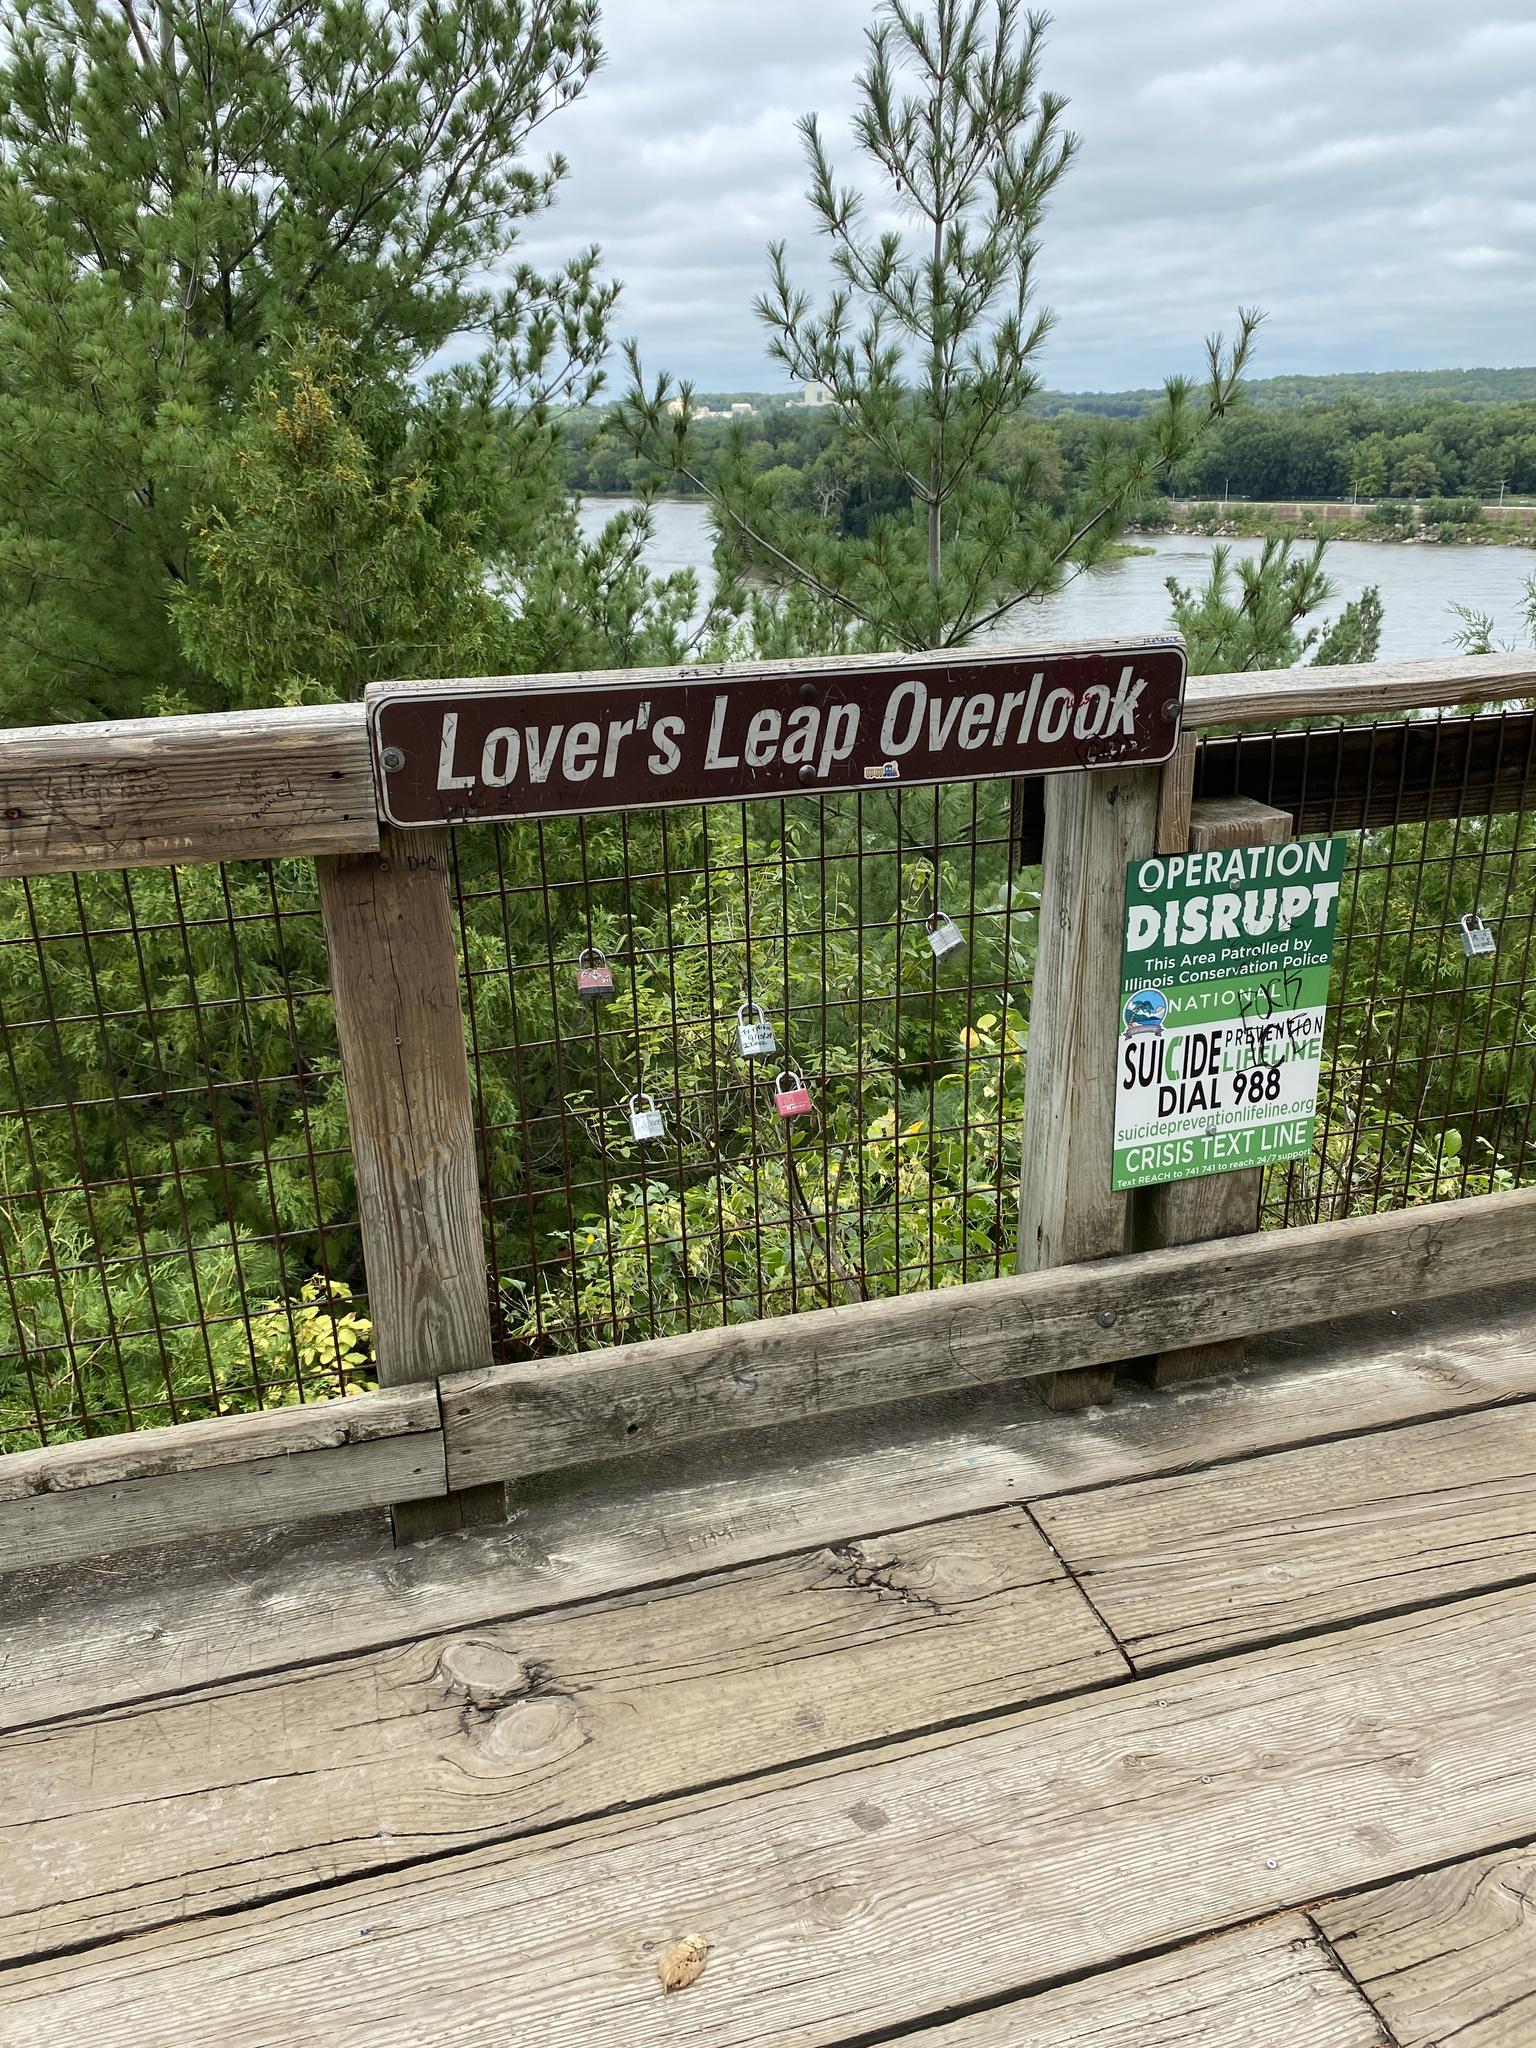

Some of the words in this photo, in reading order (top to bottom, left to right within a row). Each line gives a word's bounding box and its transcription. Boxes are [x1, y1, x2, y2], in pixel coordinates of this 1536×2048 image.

[437, 701, 686, 790] Lover's
[704, 695, 860, 778] Leap
[880, 666, 1149, 756] Overlook
[1138, 840, 1332, 893] OPERATION
[1126, 881, 1339, 952] DISRUPT
[1124, 973, 1174, 992] Illinois
[1179, 960, 1278, 984] Conservation
[1283, 952, 1329, 969] Police
[1145, 957, 1176, 972] This
[1180, 952, 1216, 967] Area
[1221, 938, 1290, 961] Patrolled
[1293, 938, 1313, 952] by
[1168, 983, 1281, 1014] NATIONAL
[1123, 1030, 1222, 1090] SUICIDE
[1222, 1037, 1320, 1072] LIFELINE
[1158, 1078, 1221, 1118] DIAL
[1232, 1068, 1281, 1106] 988
[1117, 1097, 1314, 1142] suicidepreventionlifeline.org
[1117, 1178, 1136, 1188] Text
[1138, 1171, 1171, 1184] REACH
[1186, 1166, 1199, 1176] 741
[1202, 1163, 1216, 1173] 741
[1218, 1162, 1228, 1170] to
[1229, 1157, 1254, 1168] reach
[1256, 1152, 1277, 1164] 24/7
[1125, 1140, 1194, 1173] CRISIS
[1201, 1130, 1255, 1160] TEXT
[1261, 1120, 1308, 1150] LINE
